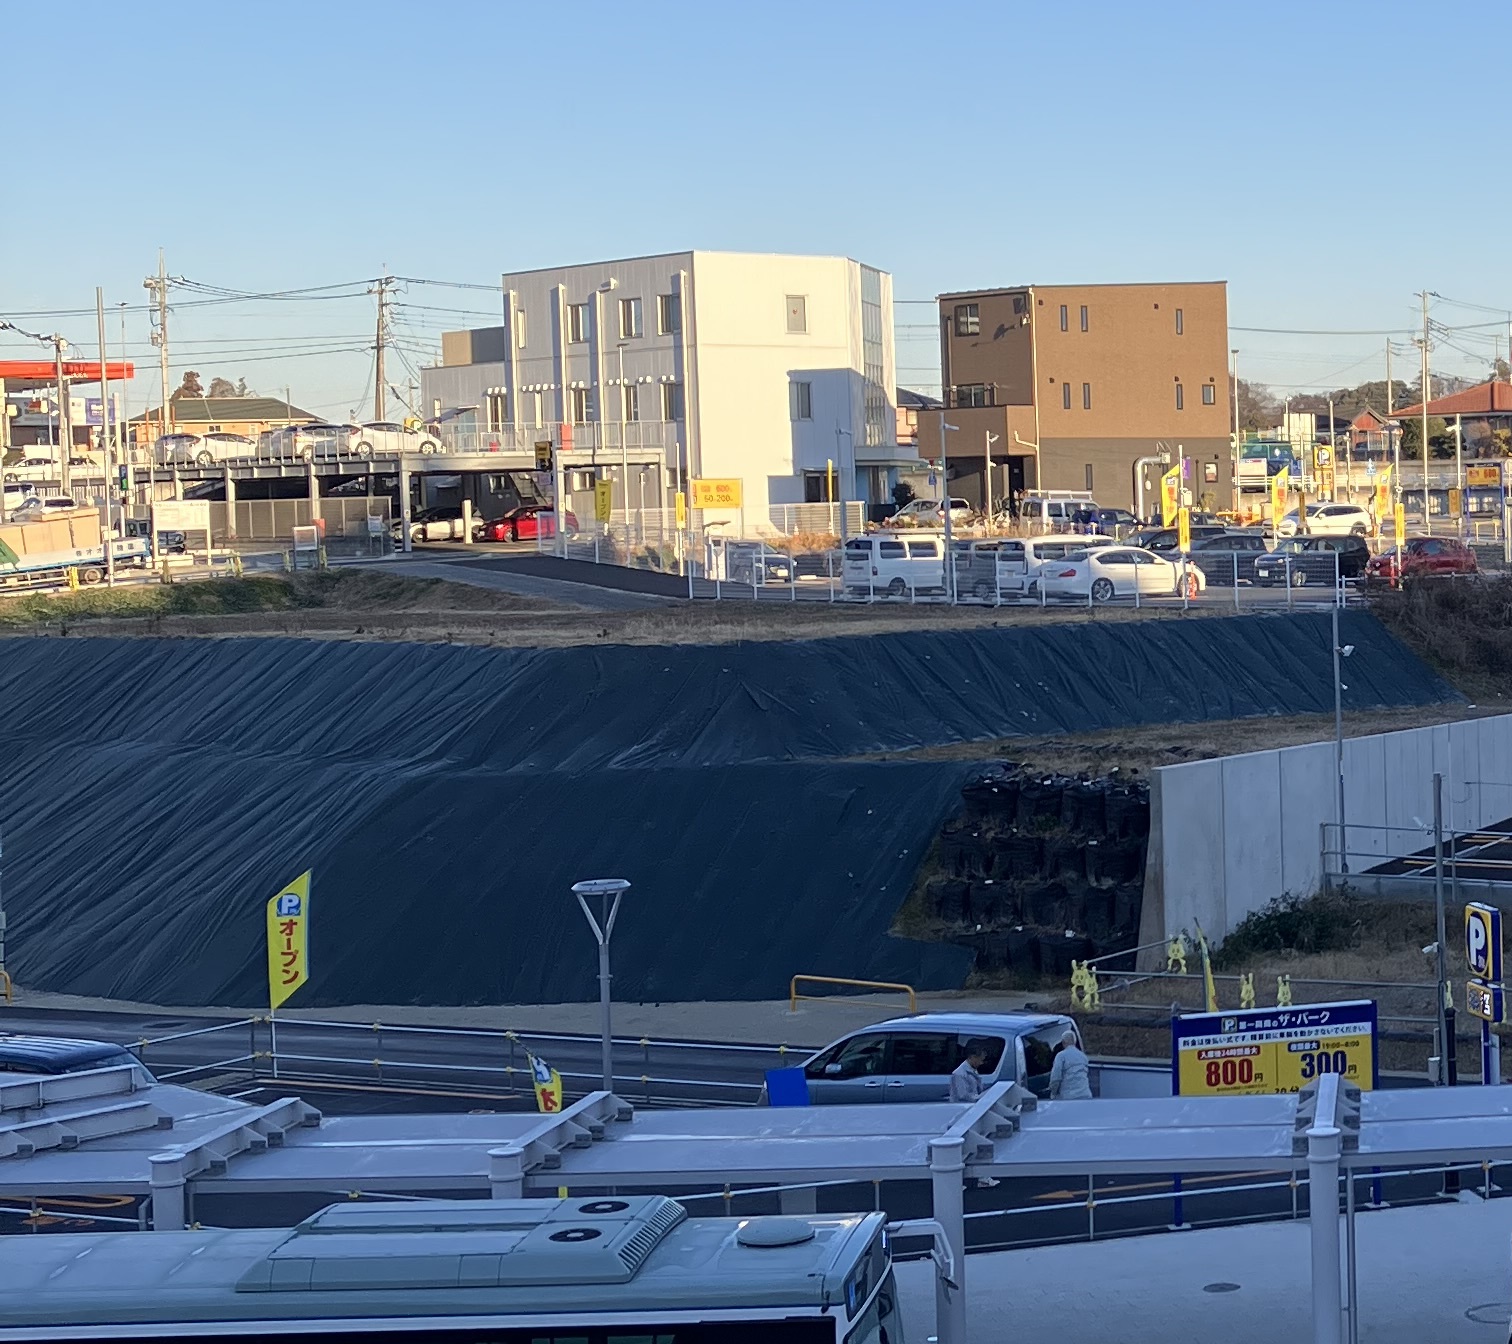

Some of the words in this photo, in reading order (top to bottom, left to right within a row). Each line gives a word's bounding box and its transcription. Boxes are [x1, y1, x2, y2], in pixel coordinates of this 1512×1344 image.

[280, 894, 300, 916] P
[279, 918, 300, 986] オープン
[1470, 915, 1486, 966] P
[1206, 1058, 1263, 1087] 800円
